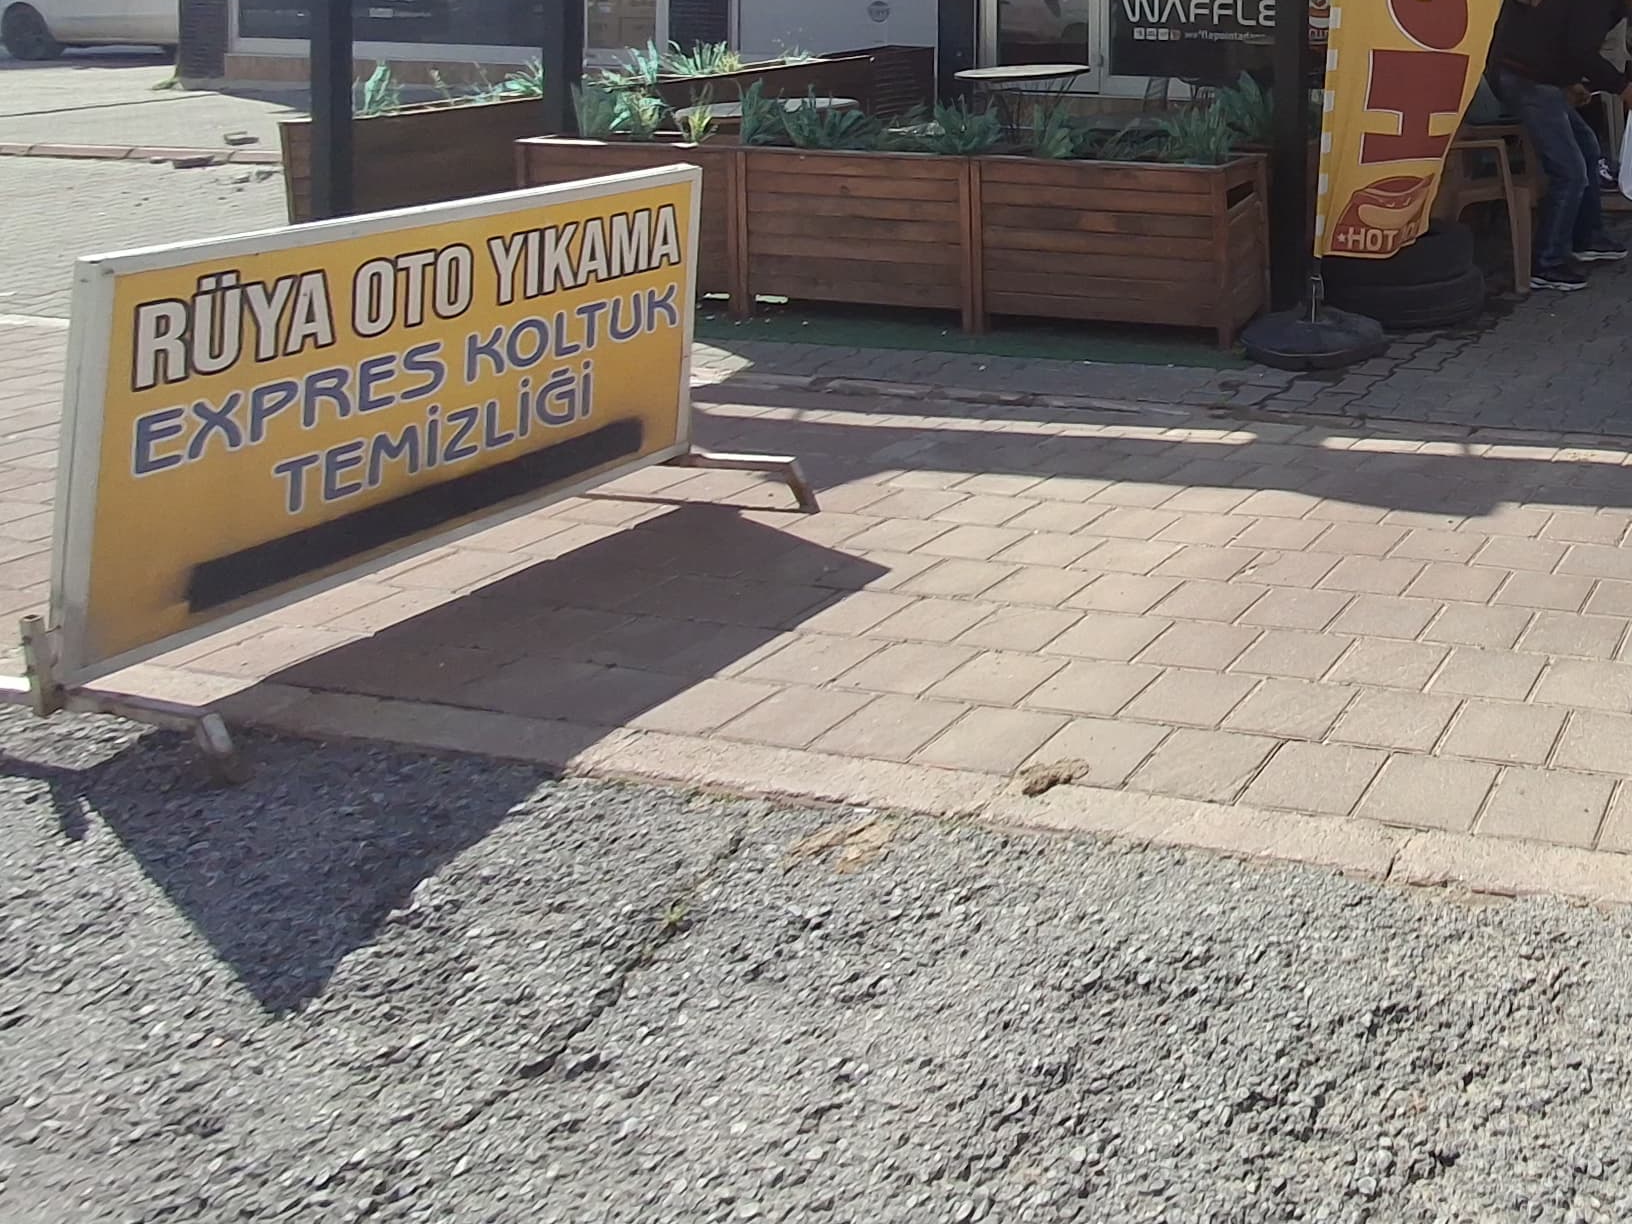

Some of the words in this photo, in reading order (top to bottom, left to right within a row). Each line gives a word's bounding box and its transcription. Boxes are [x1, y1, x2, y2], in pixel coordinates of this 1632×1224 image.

[131, 269, 335, 392] RÜYA
[351, 243, 474, 338] OTO
[486, 203, 682, 307] YIKAMA
[1346, 227, 1400, 252] HOT
[133, 341, 447, 476] EXPRES
[464, 283, 679, 383] KOLTUK
[272, 360, 593, 512] TEMİZLİĞİ
